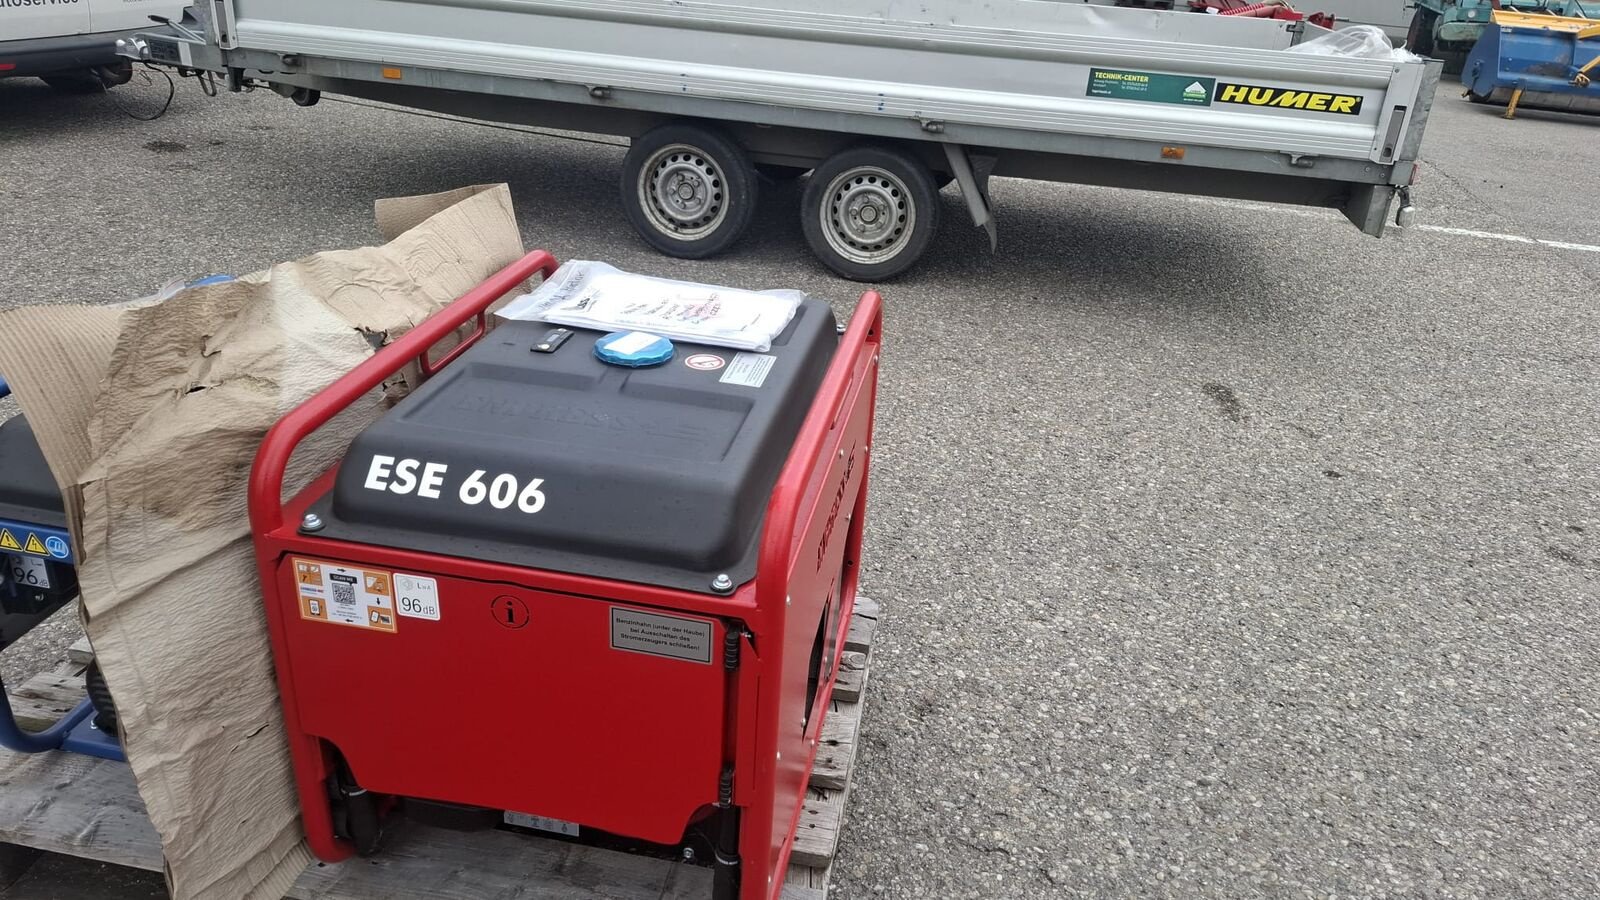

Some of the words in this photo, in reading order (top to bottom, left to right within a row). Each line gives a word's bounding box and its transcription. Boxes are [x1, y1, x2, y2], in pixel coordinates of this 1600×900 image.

[1095, 72, 1149, 82] TECHNIK-CENTER
[364, 454, 448, 499] ESE
[458, 470, 546, 514] 606
